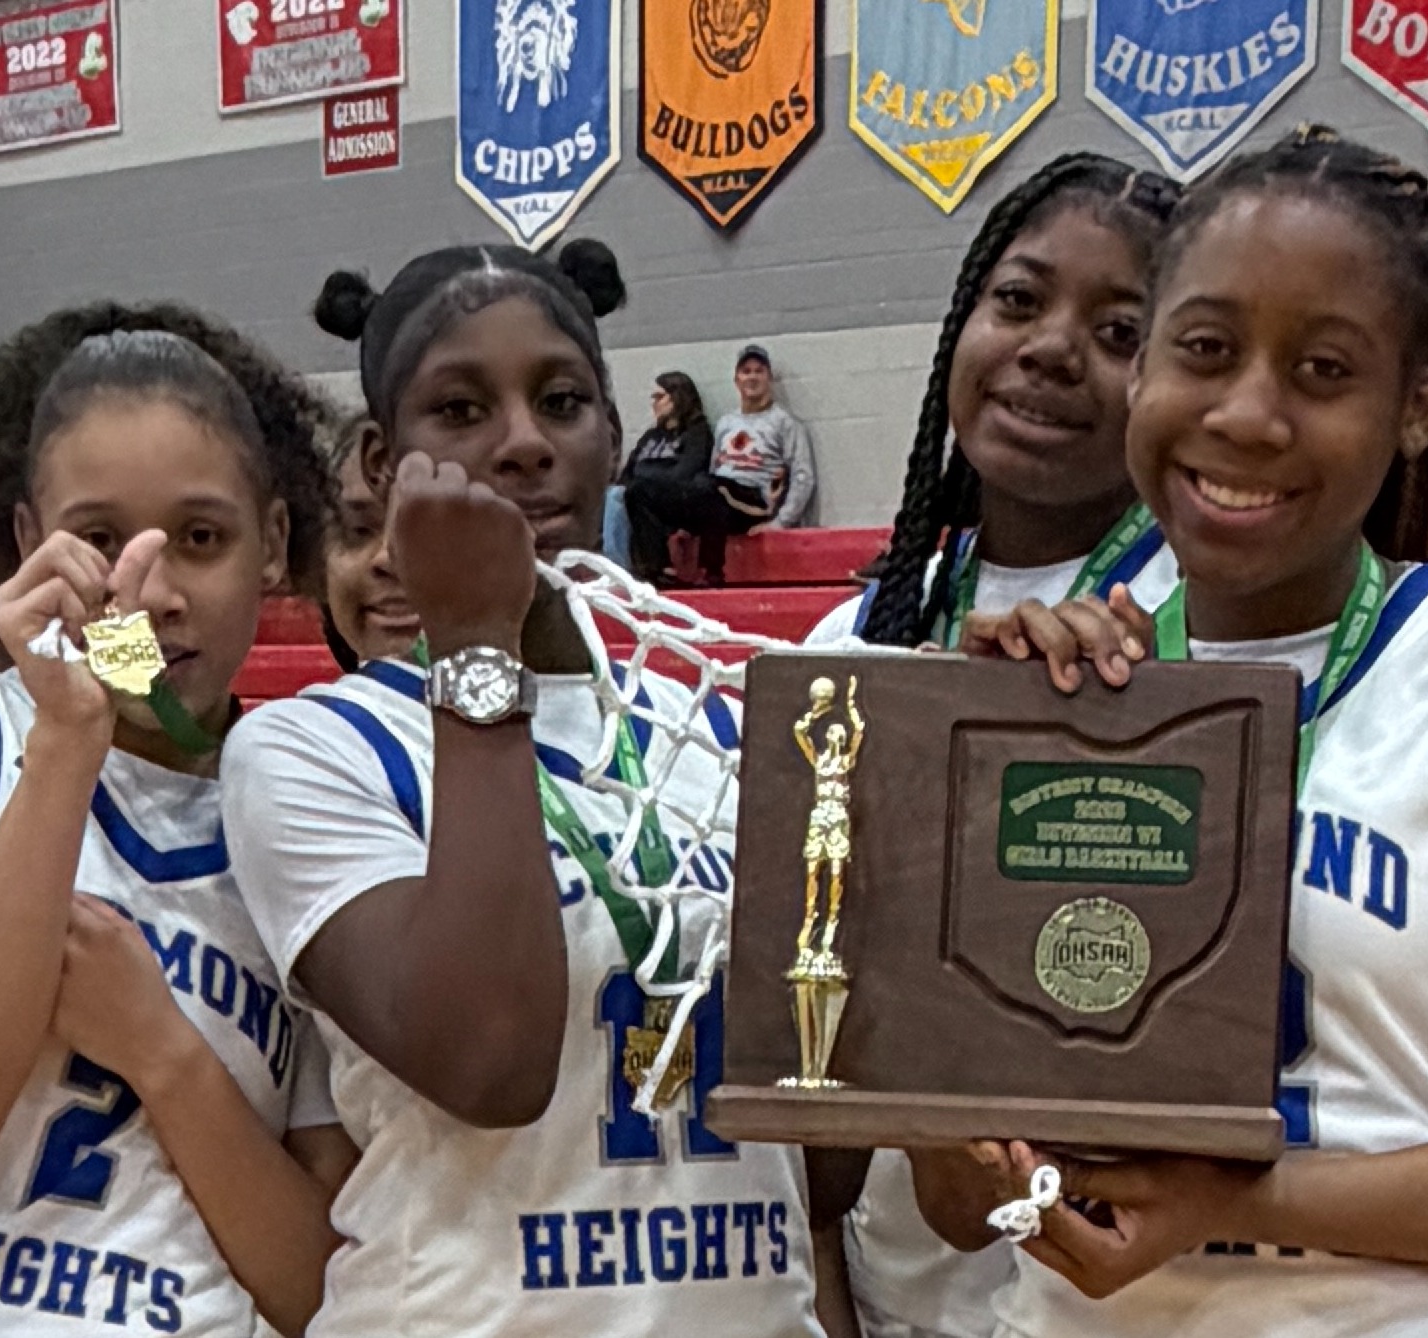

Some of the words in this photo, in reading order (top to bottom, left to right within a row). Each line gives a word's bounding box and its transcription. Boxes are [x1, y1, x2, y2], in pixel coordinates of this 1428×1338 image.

[6, 37, 66, 74] 2022
[861, 48, 1039, 129] FALCONS
[1099, 11, 1301, 97] HUSKIES
[328, 130, 396, 163] ADMISSION
[333, 97, 390, 129] GENERAL
[651, 82, 809, 158] BULLDOGS
[474, 121, 596, 184] CHIPPS
[1058, 940, 1129, 965] OHSAA
[105, 898, 293, 1090] MOND
[18, 1050, 144, 1211] 2
[518, 1202, 789, 1291] HEIGHTS
